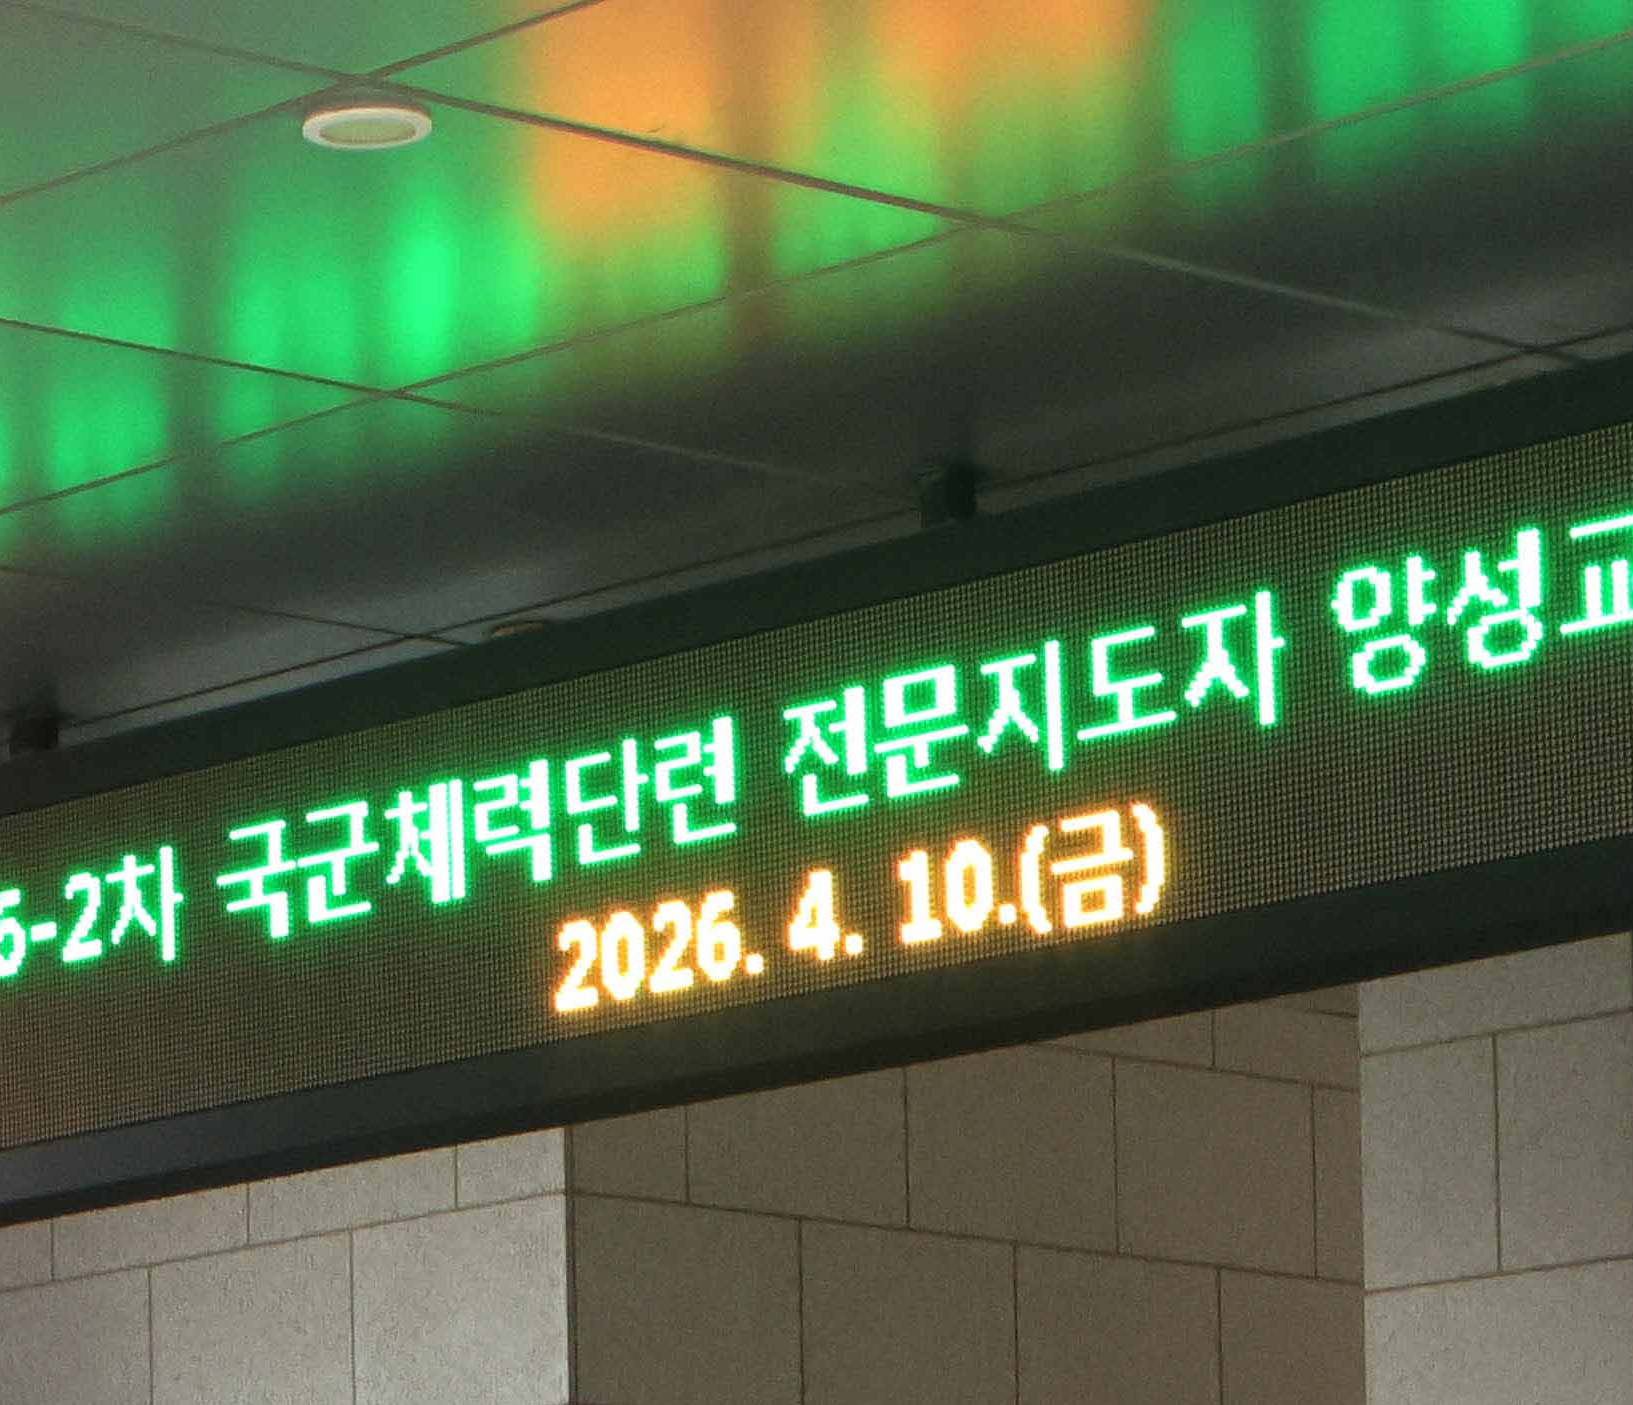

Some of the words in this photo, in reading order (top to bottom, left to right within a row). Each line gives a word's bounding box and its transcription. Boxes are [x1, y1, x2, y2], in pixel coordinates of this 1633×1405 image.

[216, 712, 738, 942] 국군체력단련
[781, 590, 1288, 814] 전문지도자
[552, 890, 766, 1018] 2026.
[781, 866, 868, 967] 4.
[894, 800, 1171, 951] 10.(금)
